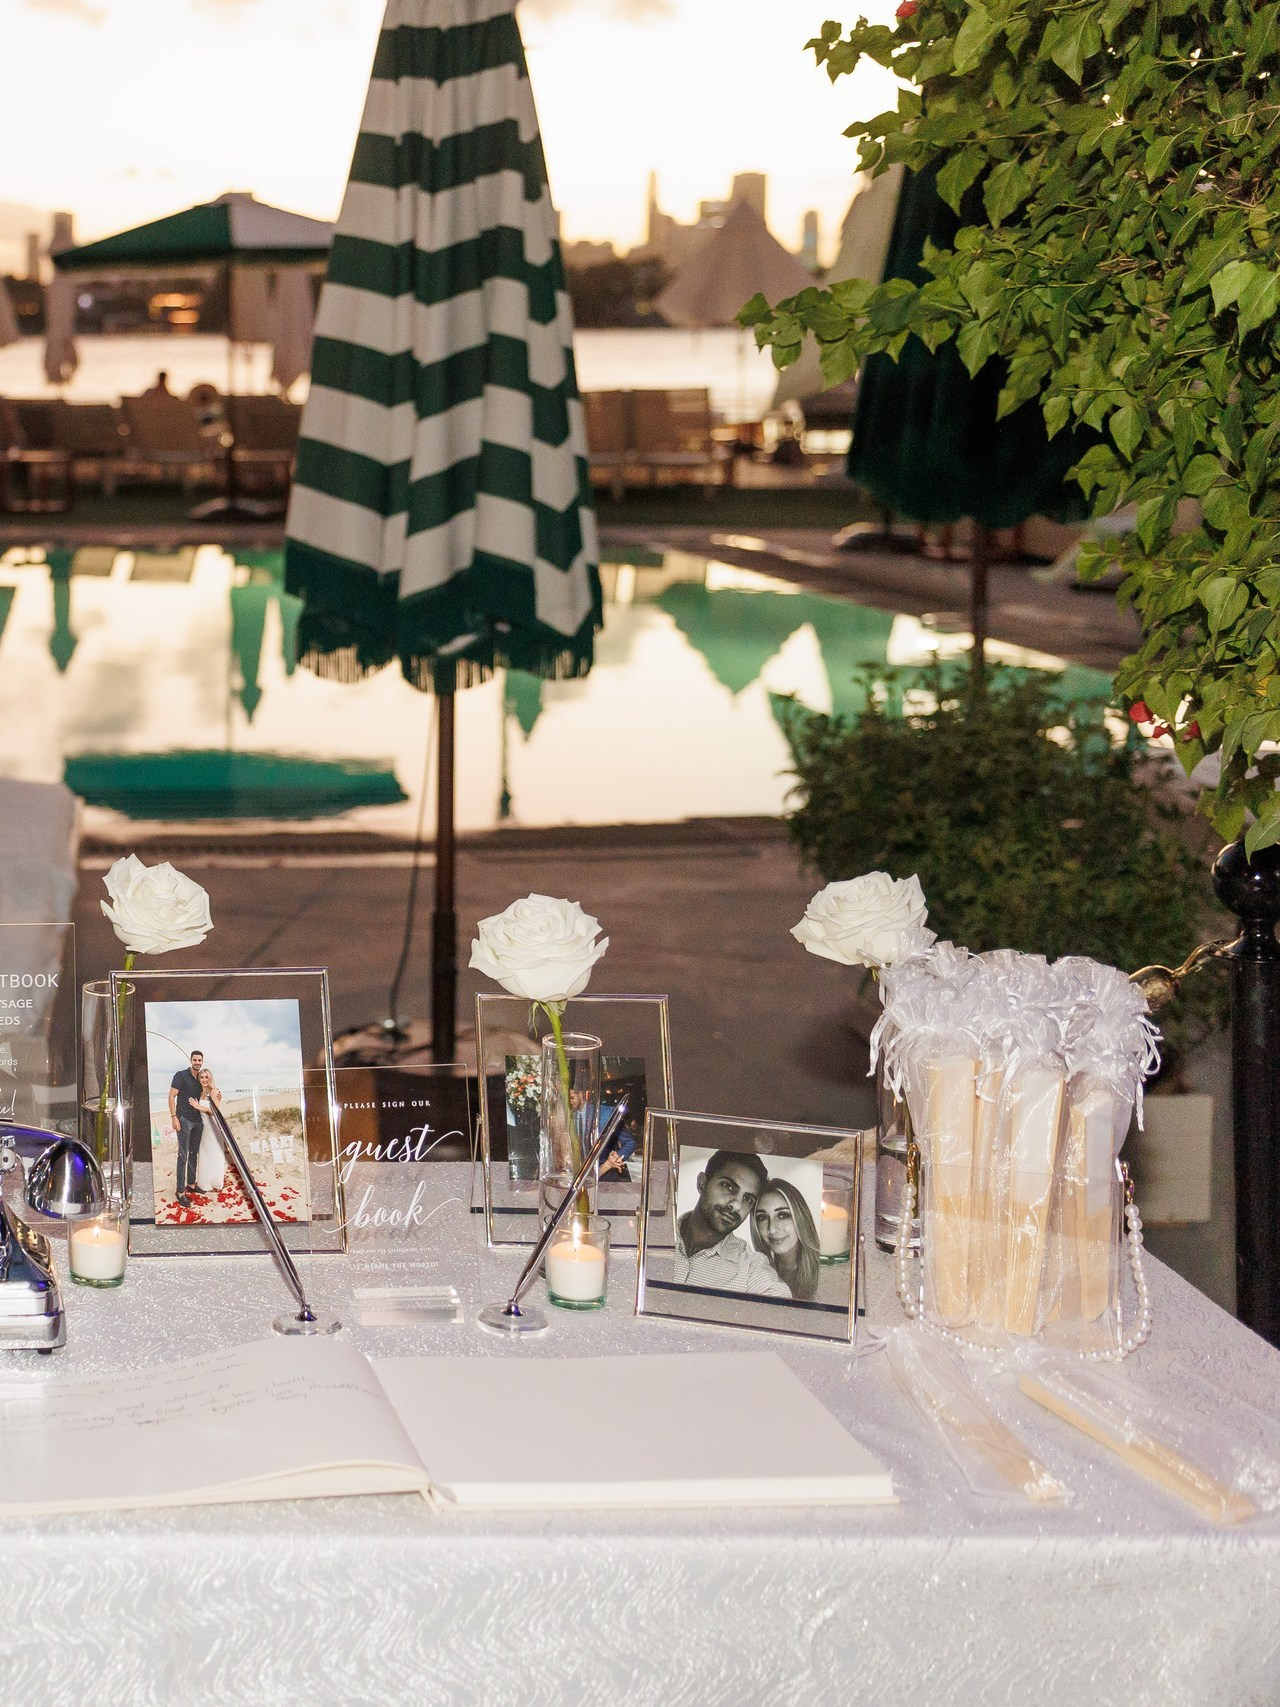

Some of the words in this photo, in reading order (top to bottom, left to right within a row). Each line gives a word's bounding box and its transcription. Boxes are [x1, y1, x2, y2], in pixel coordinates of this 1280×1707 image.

[343, 1101, 376, 1110] PLEASE
[382, 1100, 406, 1108] SIGN
[411, 1099, 431, 1107] OUR
[313, 1123, 464, 1184] guest
[322, 1180, 464, 1234] book
